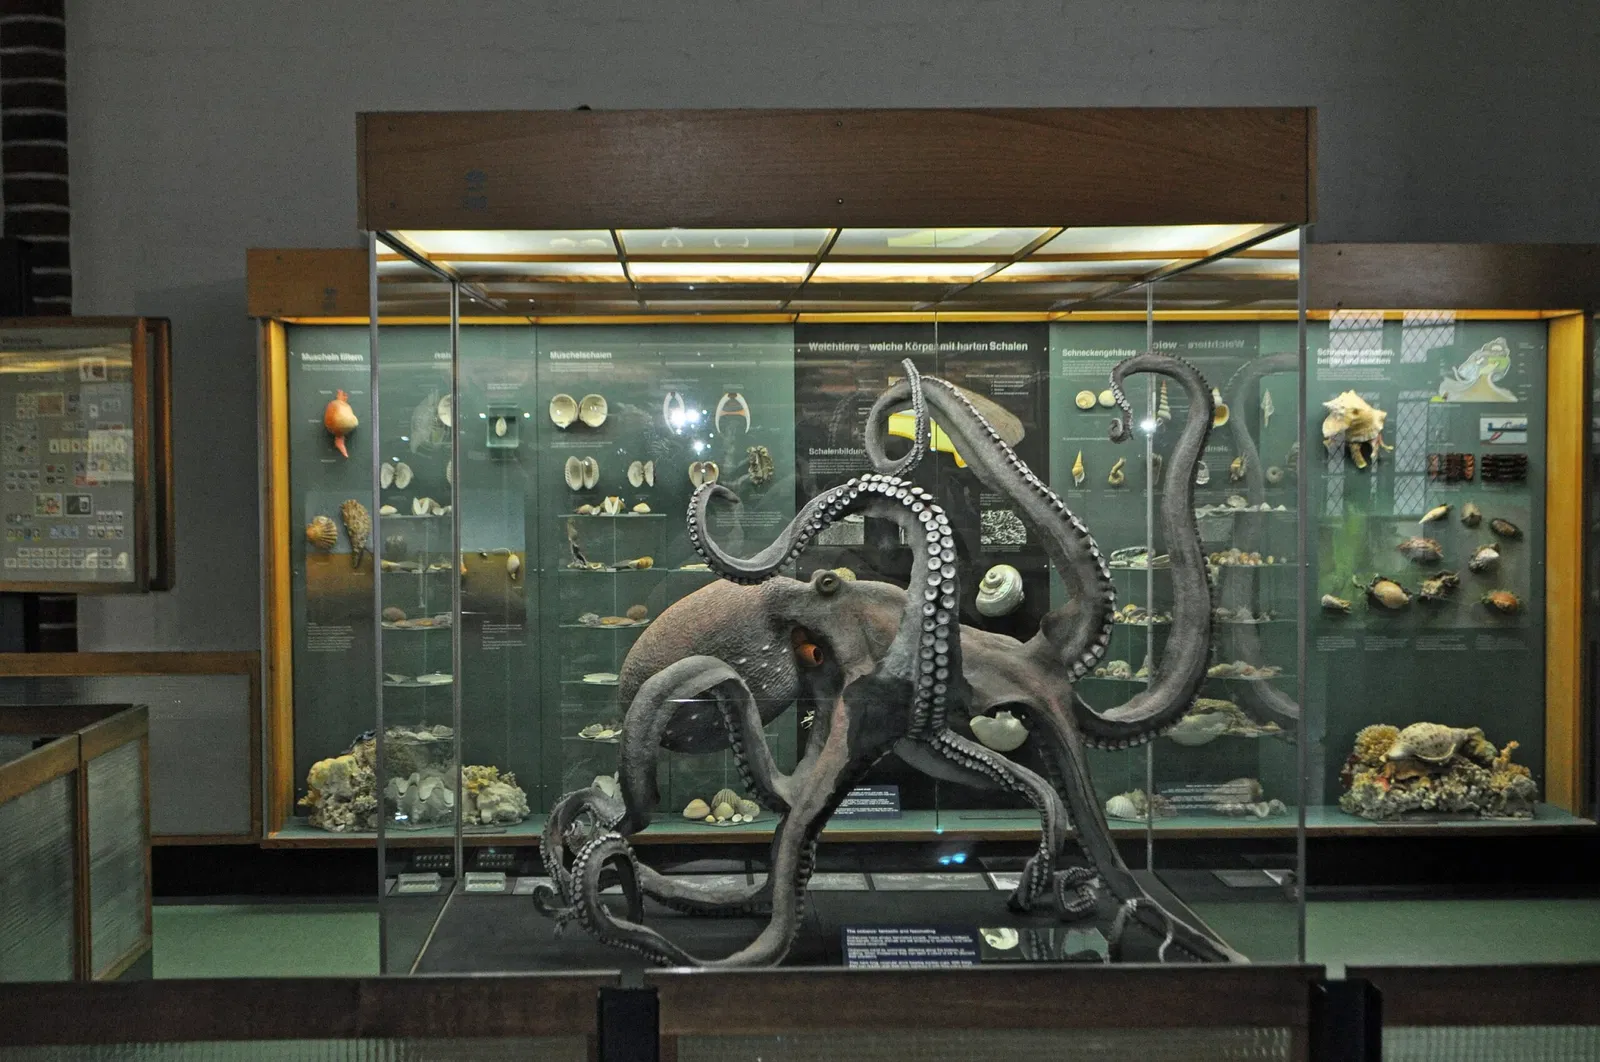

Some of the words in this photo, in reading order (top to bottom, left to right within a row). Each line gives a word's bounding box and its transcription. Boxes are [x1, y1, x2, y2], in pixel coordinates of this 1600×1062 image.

[808, 341, 860, 351] Weichtiere
[940, 341, 955, 351] mit
[957, 341, 988, 351] harten
[989, 341, 1029, 351] Schalen
[550, 351, 612, 360] Muschelschalen
[1062, 348, 1137, 358] Schneckengehäuse
